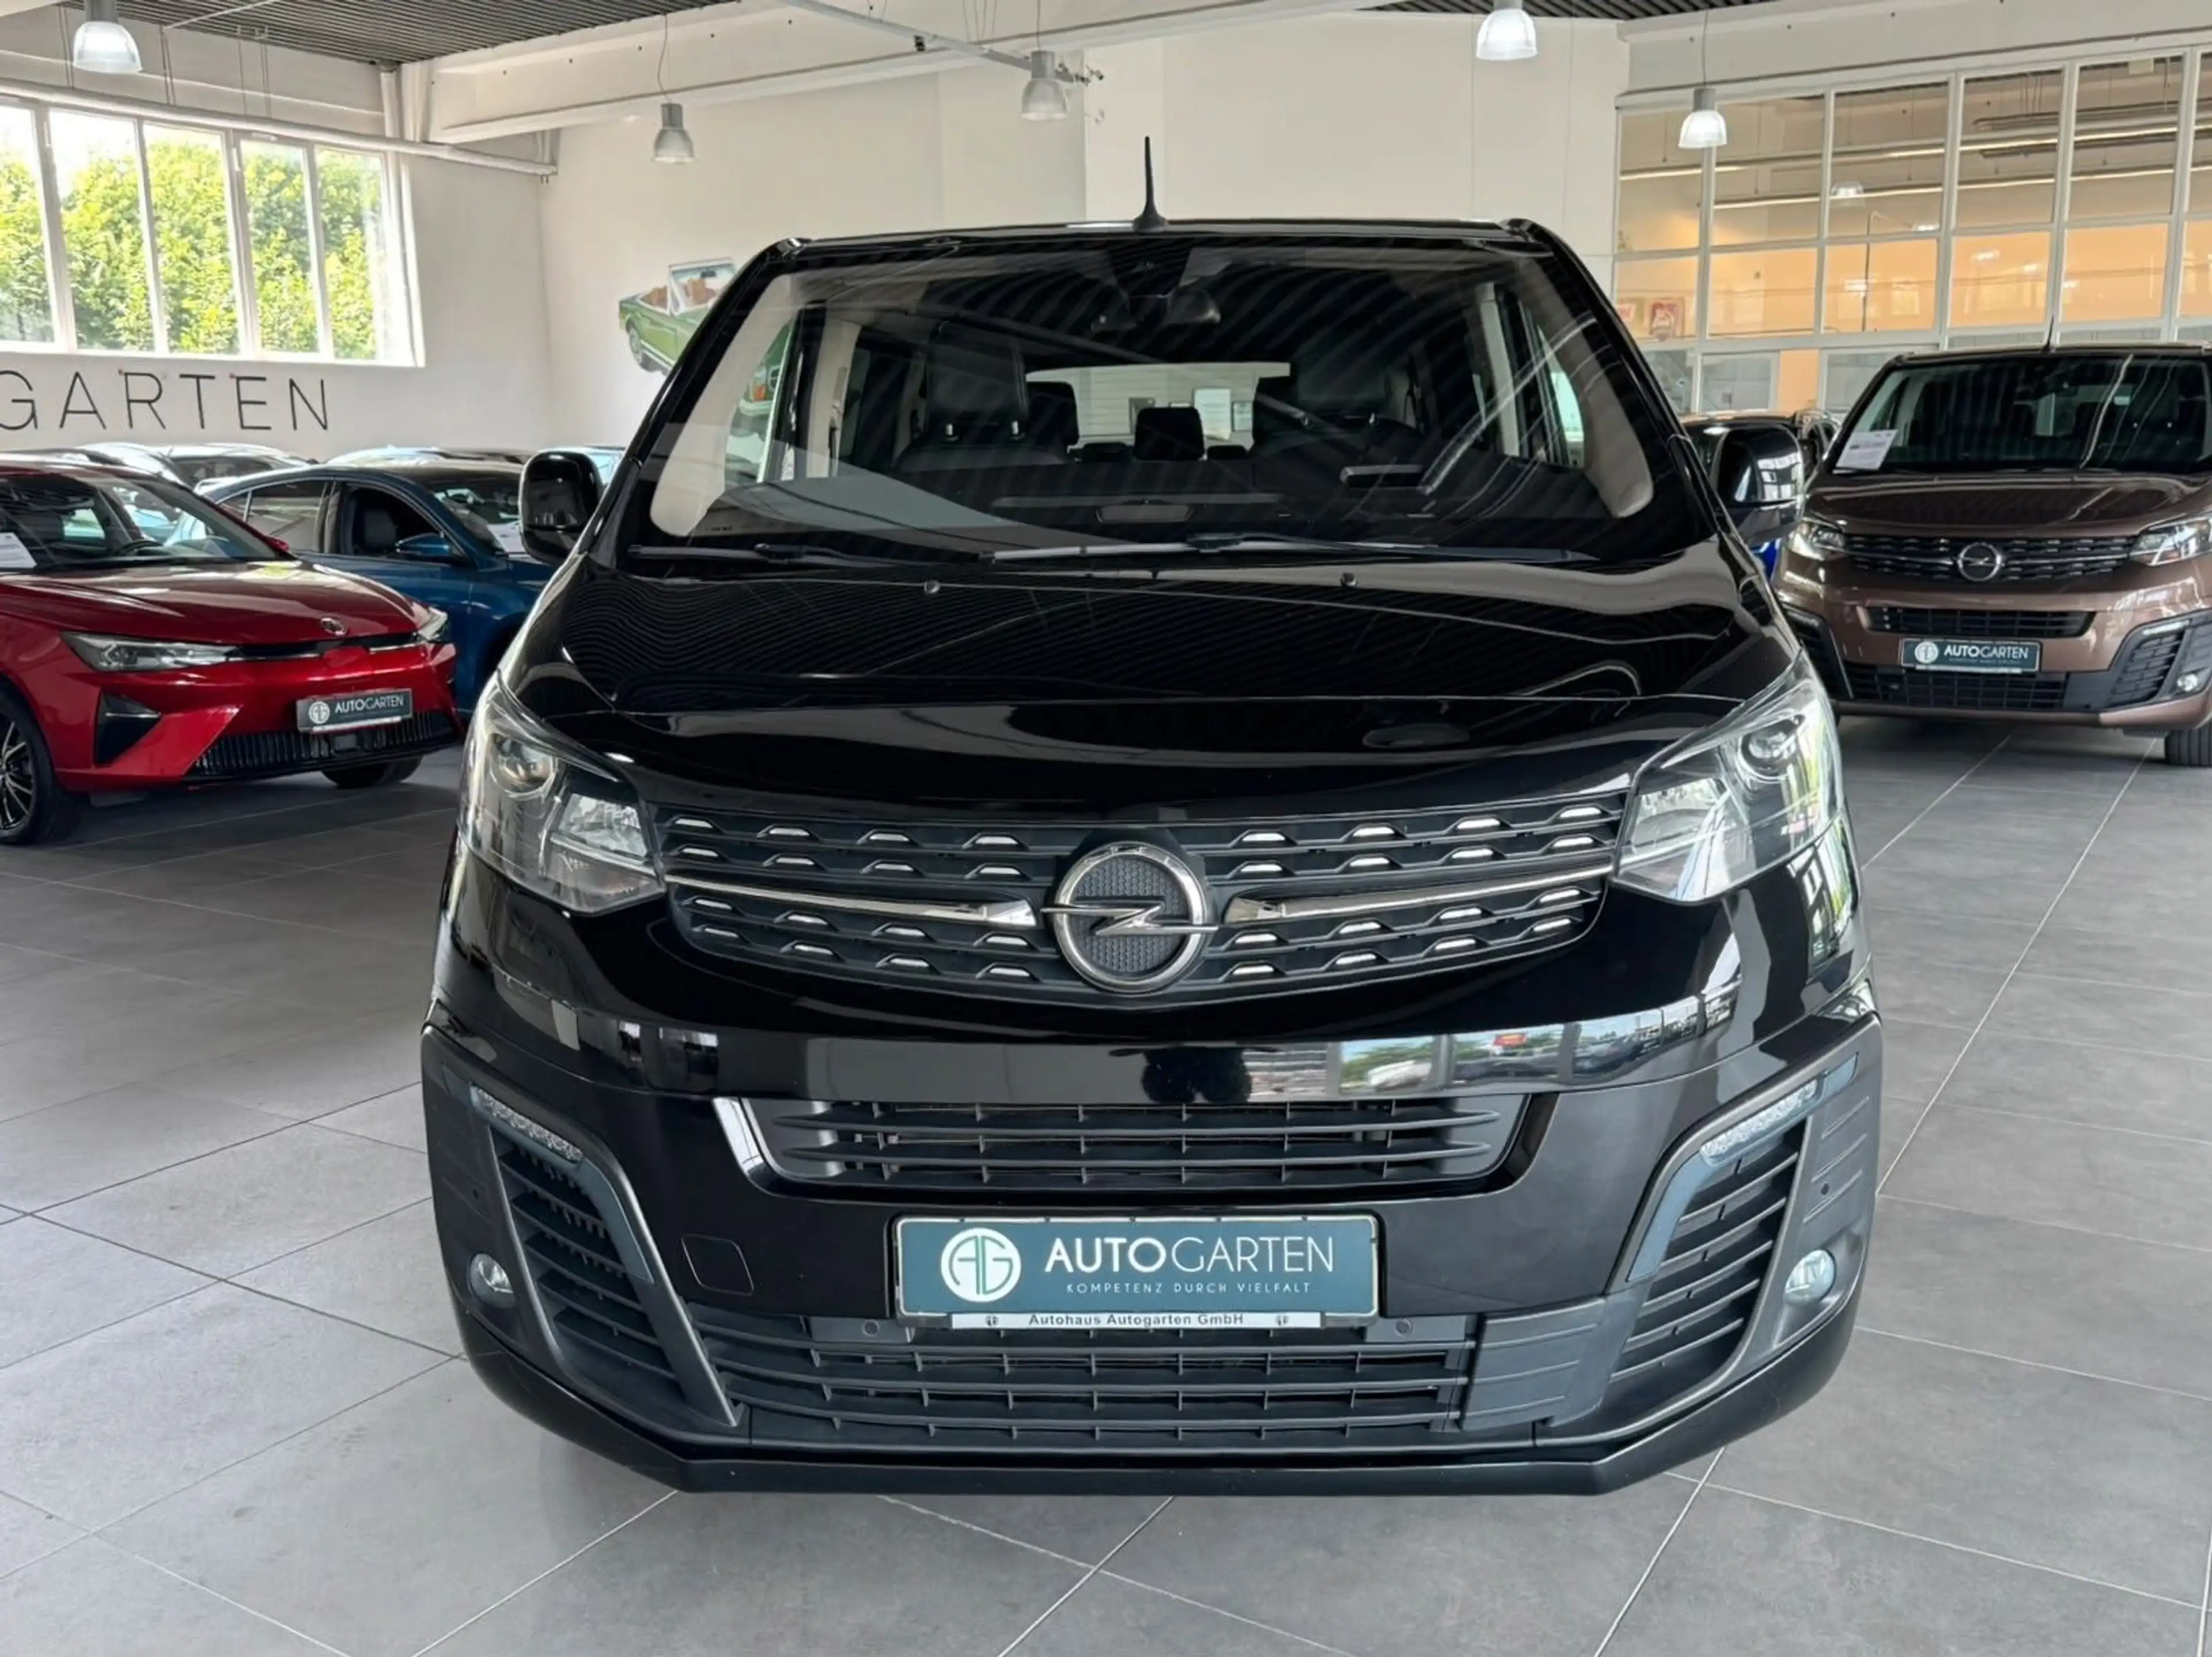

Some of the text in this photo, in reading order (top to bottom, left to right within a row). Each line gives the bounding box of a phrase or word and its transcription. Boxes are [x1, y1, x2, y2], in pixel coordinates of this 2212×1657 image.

[0, 370, 328, 431] GARTEN
[1944, 644, 2029, 659] AUTOGARTEN
[335, 694, 404, 714] AUTOGARTEN
[1044, 1235, 1334, 1273] AUTOGARTEN
[1066, 1281, 1311, 1294] KOMPETENZ DURCH VIELFALT
[1029, 1313, 1244, 1329] Autohaus Autogarten GmbH
